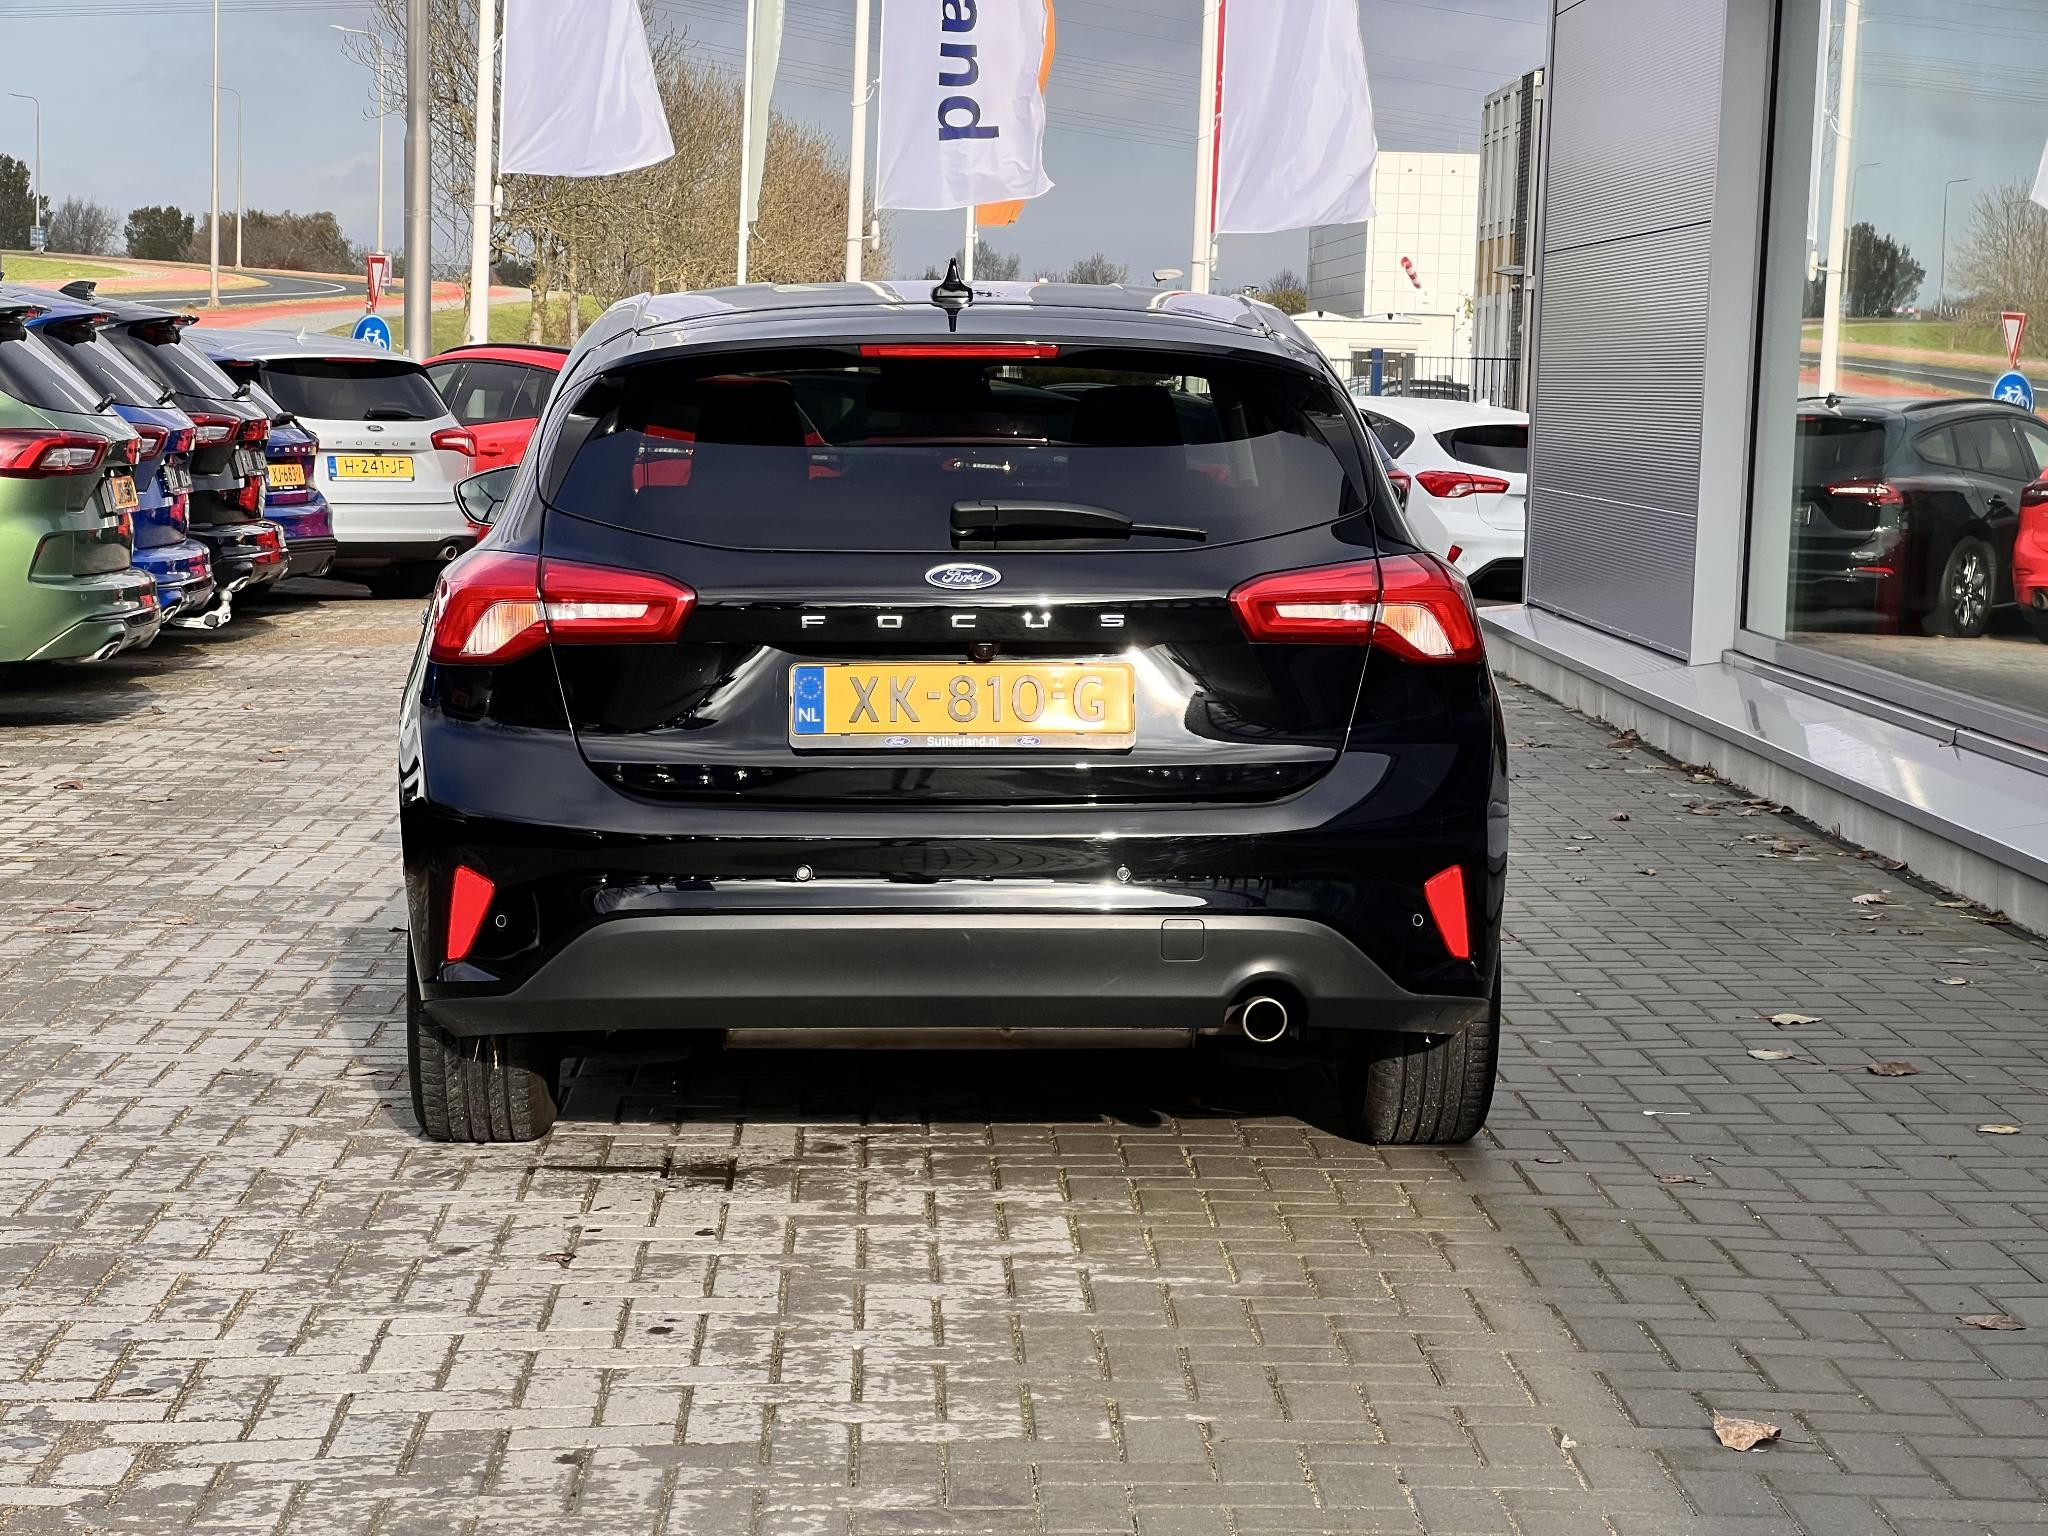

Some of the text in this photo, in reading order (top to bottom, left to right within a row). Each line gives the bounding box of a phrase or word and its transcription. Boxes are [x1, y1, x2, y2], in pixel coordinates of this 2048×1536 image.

[344, 459, 406, 474] H-241-JF
[941, 567, 984, 583] Ford
[801, 614, 1125, 629] FOCUS
[798, 675, 1105, 723] NL XK-810-G
[927, 736, 999, 747] Sutherland.nl
